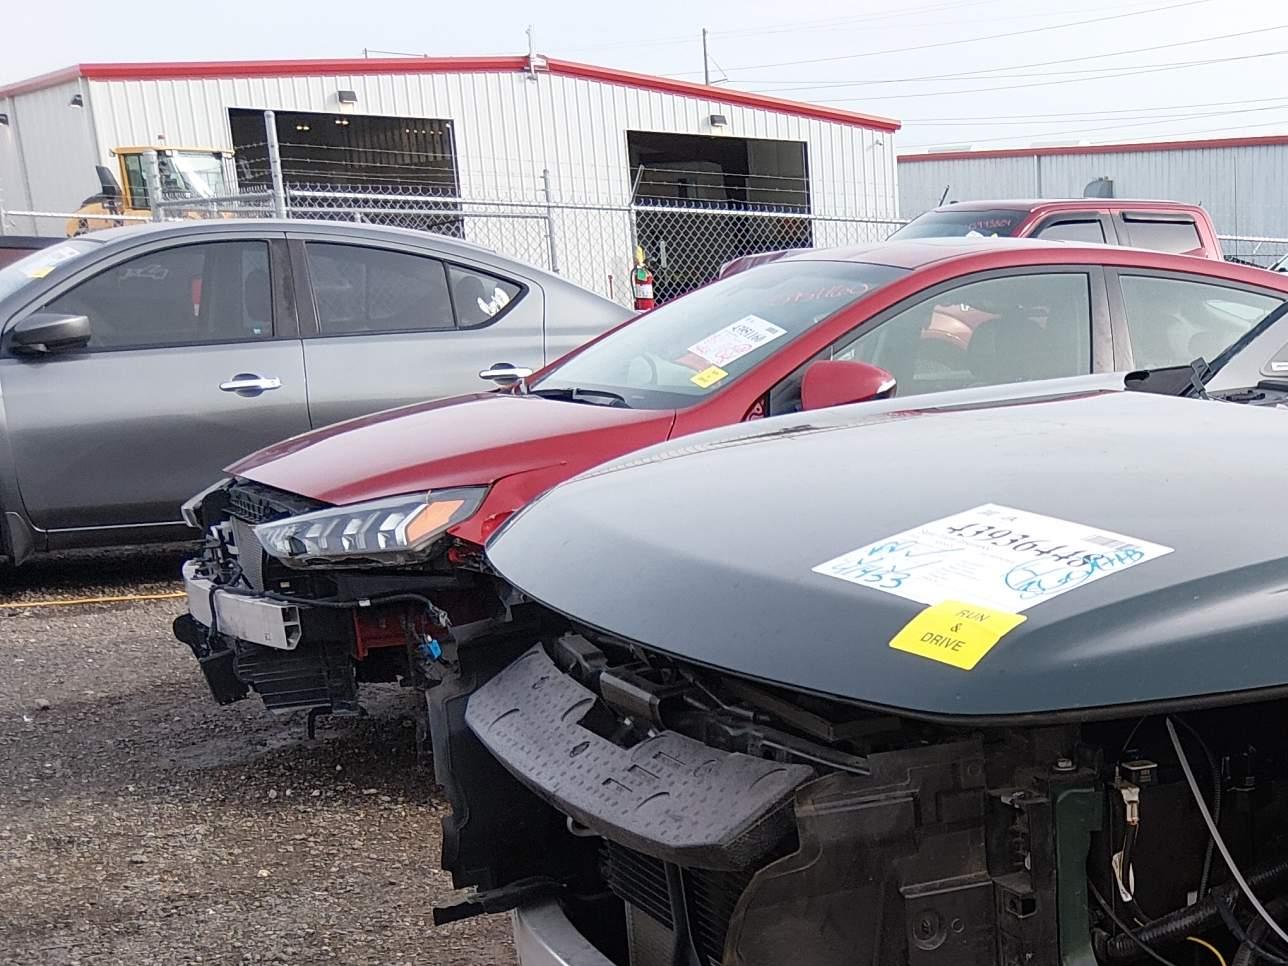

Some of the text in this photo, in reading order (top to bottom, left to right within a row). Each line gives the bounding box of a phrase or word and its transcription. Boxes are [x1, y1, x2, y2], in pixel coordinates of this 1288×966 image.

[955, 609, 991, 622] RUN
[950, 622, 963, 633] &
[920, 631, 966, 652] DRIVE
